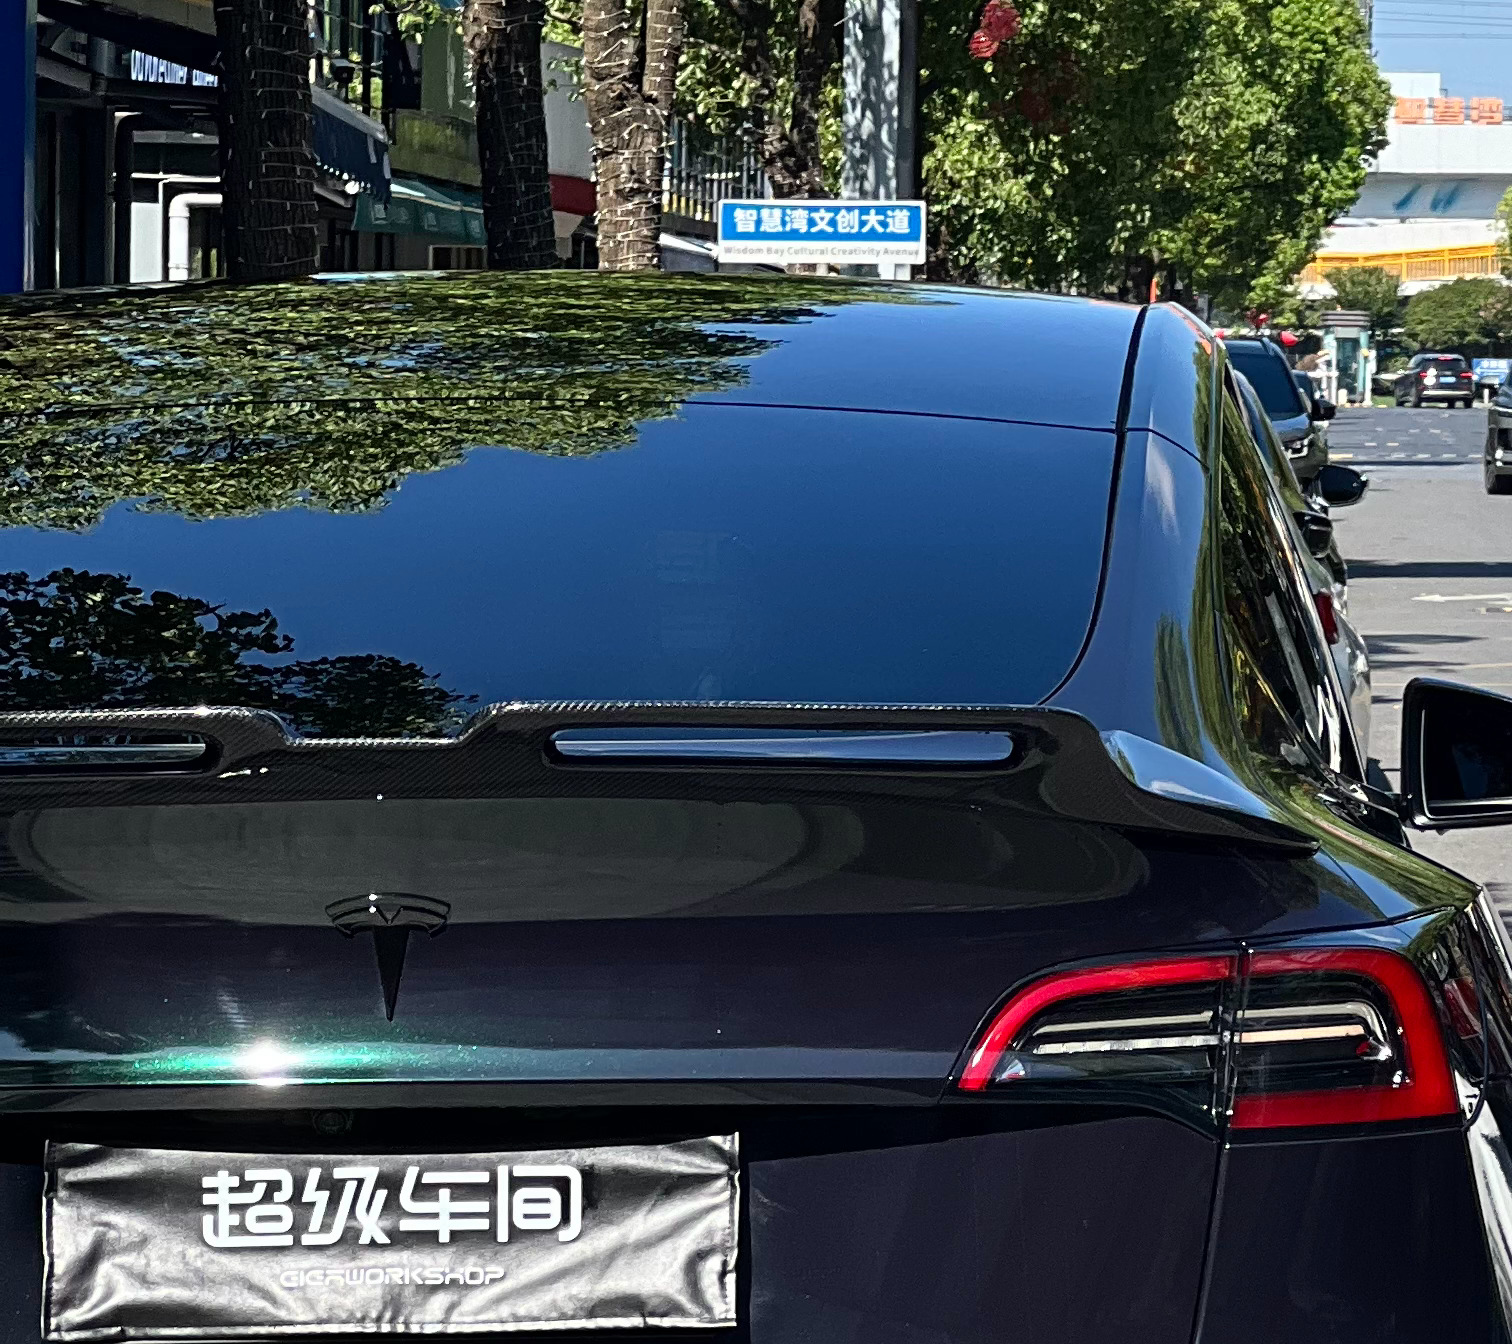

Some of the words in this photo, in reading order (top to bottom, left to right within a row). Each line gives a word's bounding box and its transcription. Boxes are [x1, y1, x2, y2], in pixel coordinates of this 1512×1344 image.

[733, 207, 911, 233] 智慧湾文创大道
[724, 246, 764, 255] Wisdom
[766, 246, 785, 257] Bay
[787, 246, 829, 256] Cultural
[830, 246, 881, 258] Creativity
[201, 1165, 585, 1248] 超级车间
